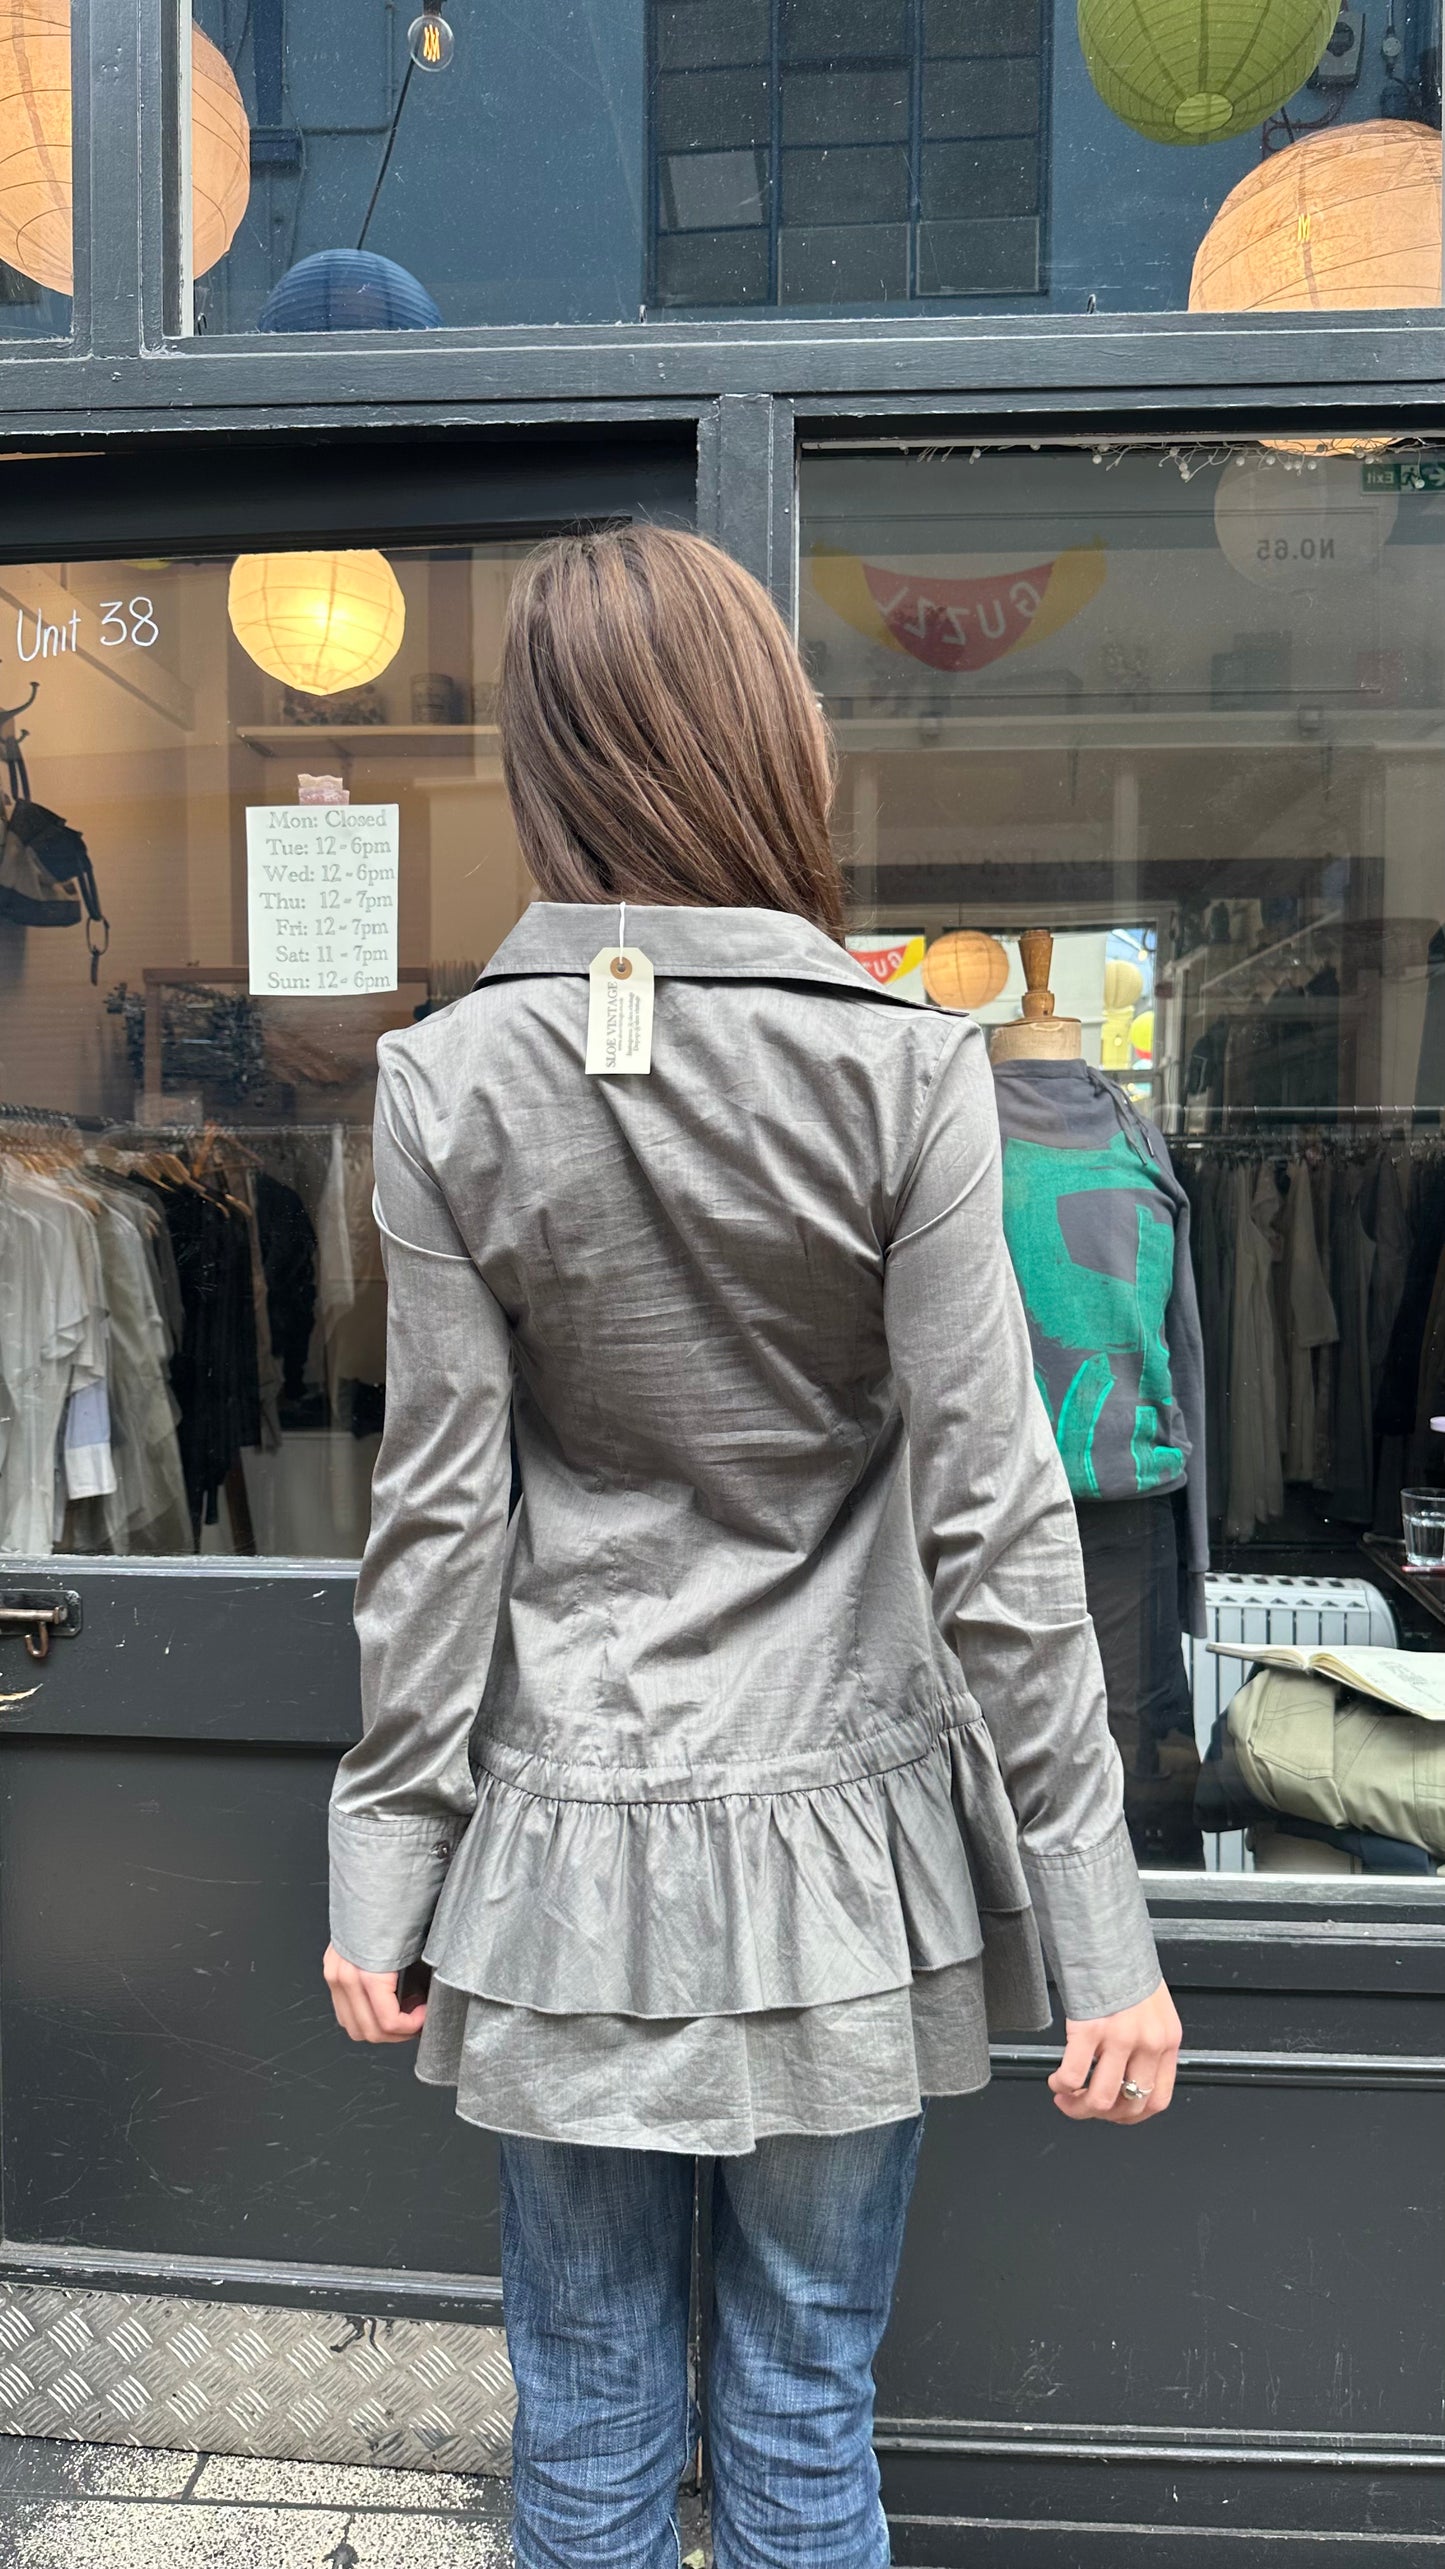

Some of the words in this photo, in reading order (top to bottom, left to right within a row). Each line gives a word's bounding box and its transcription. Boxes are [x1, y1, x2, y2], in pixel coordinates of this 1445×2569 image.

[16, 607, 82, 663] Unit
[100, 596, 160, 647] 38
[268, 811, 318, 829] Mon:
[324, 809, 387, 828] Closed
[265, 838, 309, 856] Tue:
[263, 865, 315, 883] Wed:
[259, 892, 306, 909] Thu:
[275, 919, 308, 936] Fri:
[275, 946, 310, 963] Sat:
[267, 972, 310, 990] Sun:
[607, 981, 618, 1036] VINTAGE
[606, 1037, 617, 1068] SLOE
